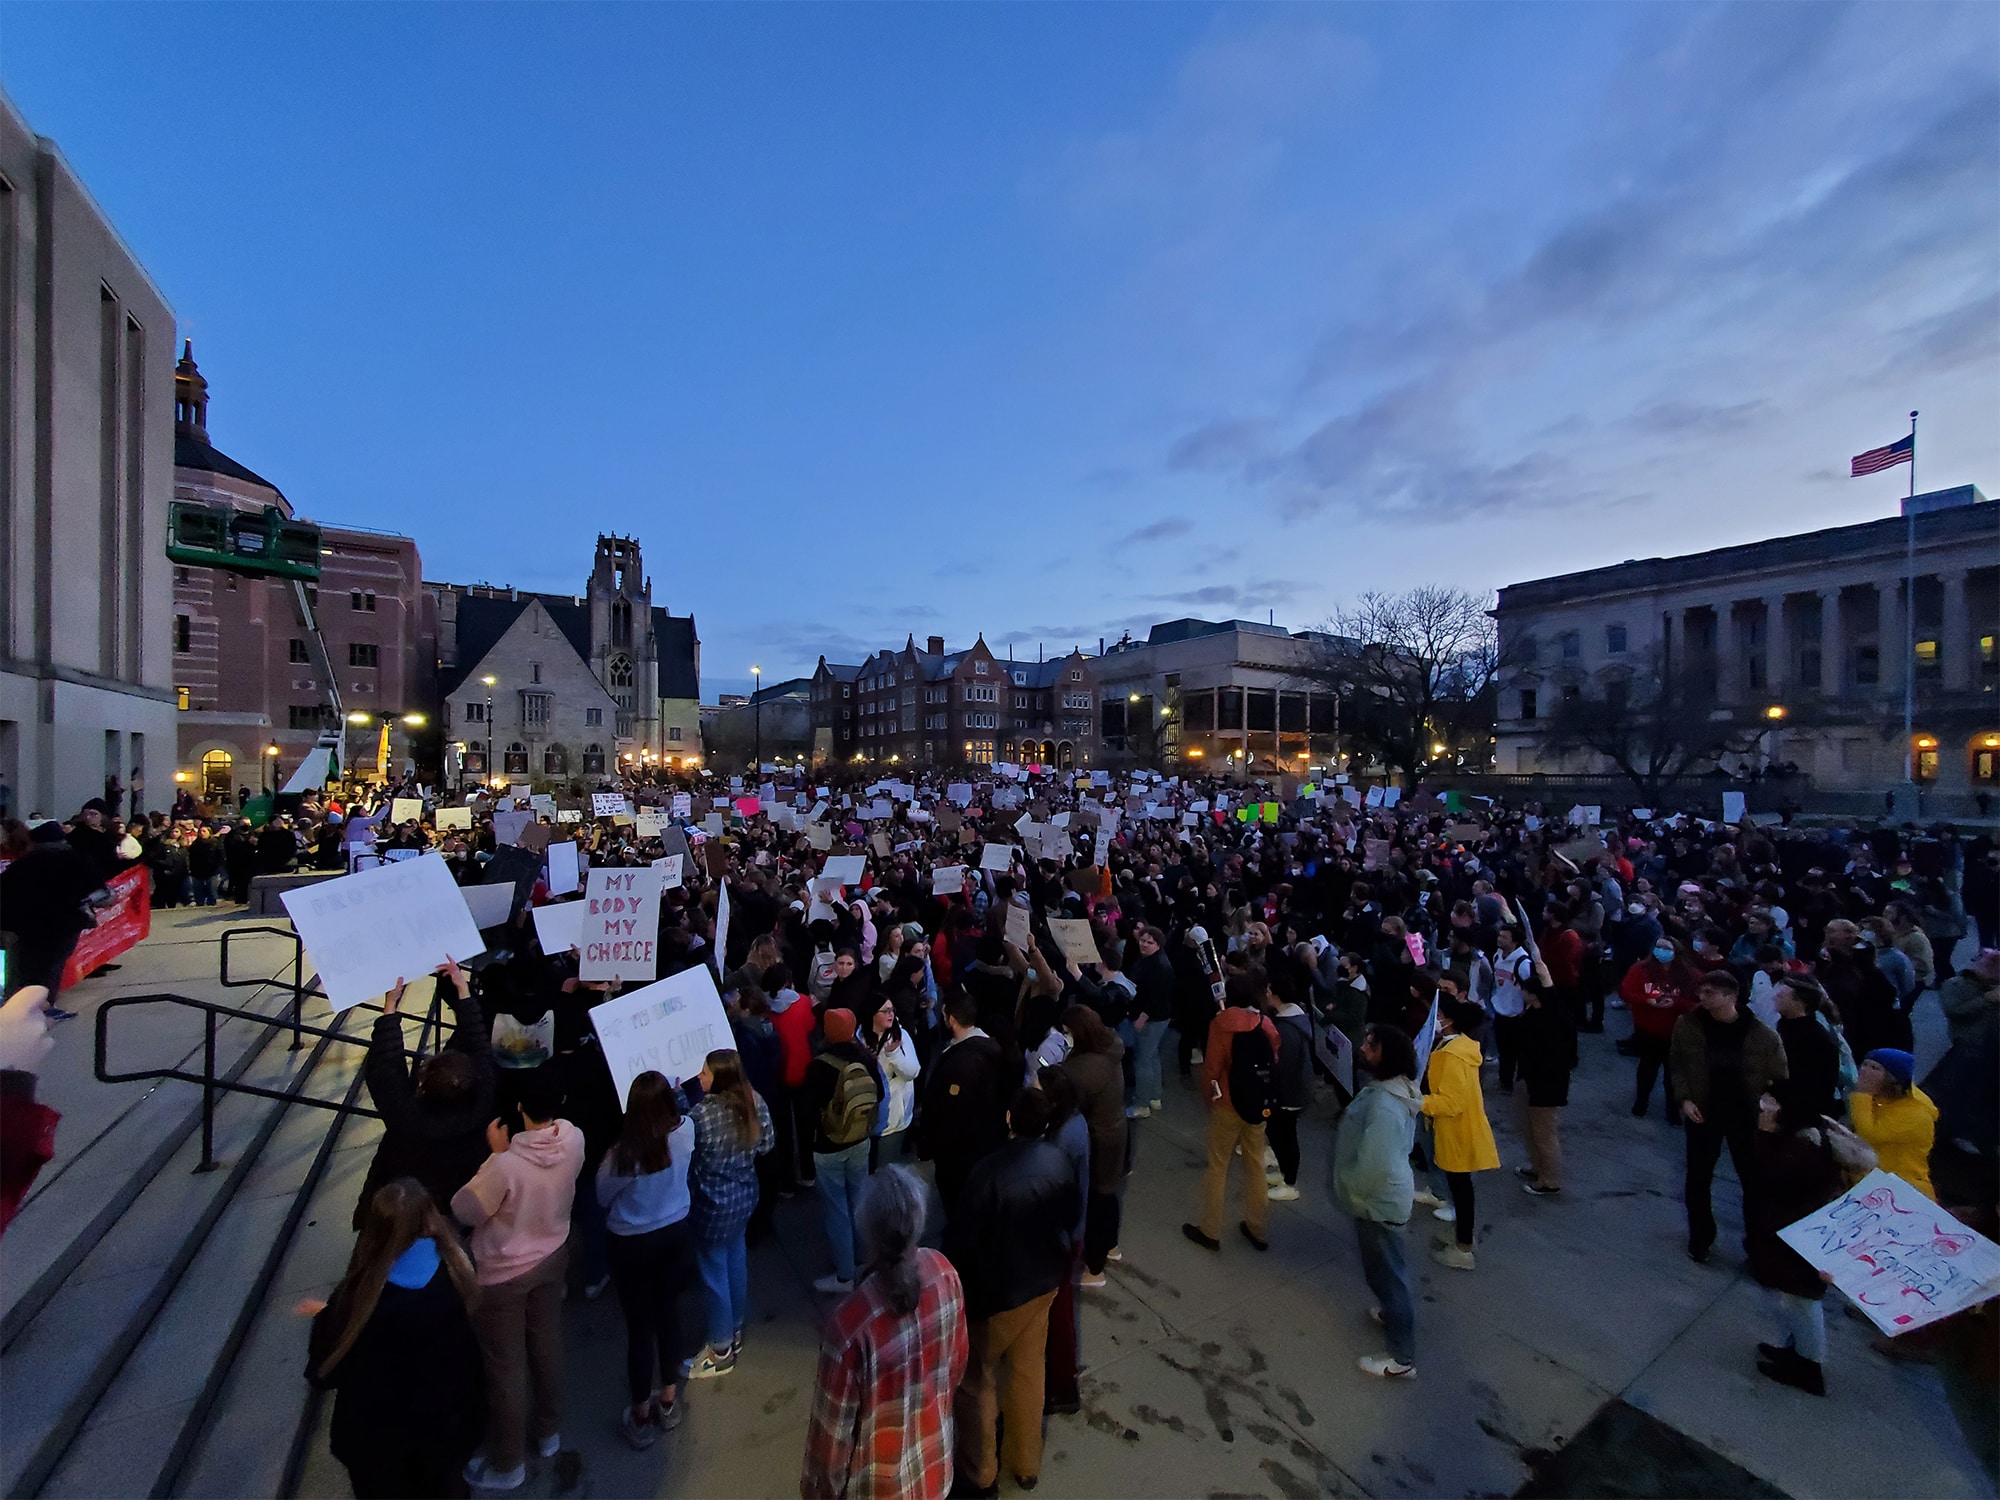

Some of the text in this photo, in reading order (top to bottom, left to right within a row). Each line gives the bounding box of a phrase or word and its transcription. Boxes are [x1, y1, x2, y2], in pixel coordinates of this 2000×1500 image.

[605, 873, 636, 891] MY
[311, 870, 425, 917] PROTECT
[589, 897, 643, 915] BODY
[605, 919, 637, 936] MY
[587, 940, 653, 962] CHOICE
